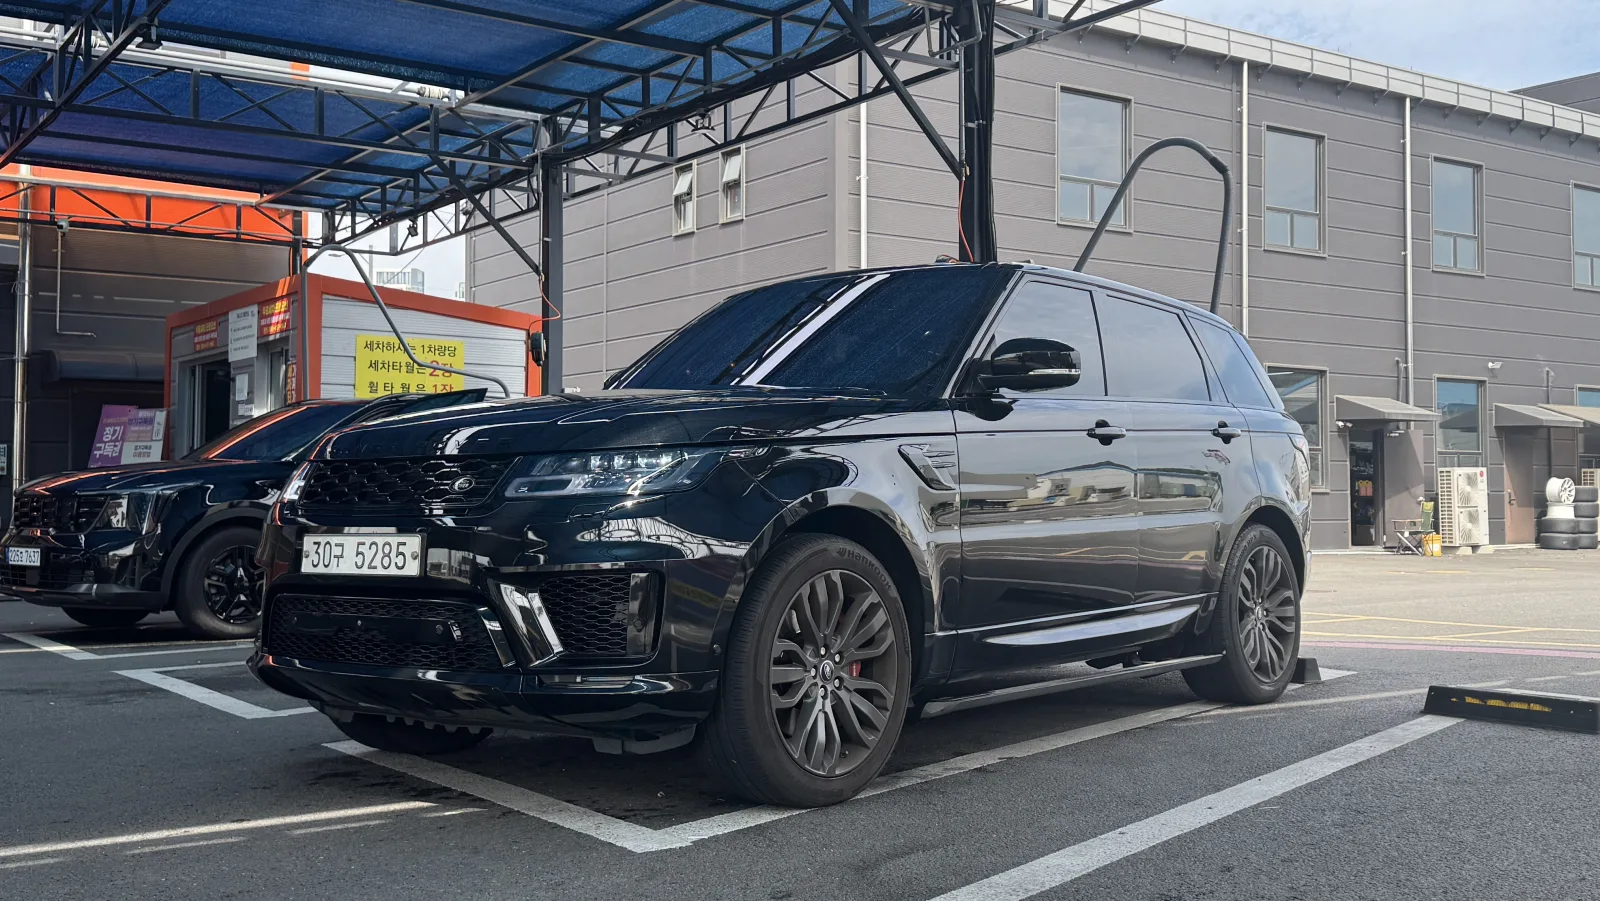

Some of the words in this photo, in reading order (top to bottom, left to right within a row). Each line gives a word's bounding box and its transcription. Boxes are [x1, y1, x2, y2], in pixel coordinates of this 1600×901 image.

[420, 343, 457, 357] 1차량당
[103, 425, 124, 442] 정기
[93, 441, 123, 459] 구독권
[25, 550, 40, 563] 7637
[311, 540, 345, 568] 30구
[354, 540, 407, 570] 5285
